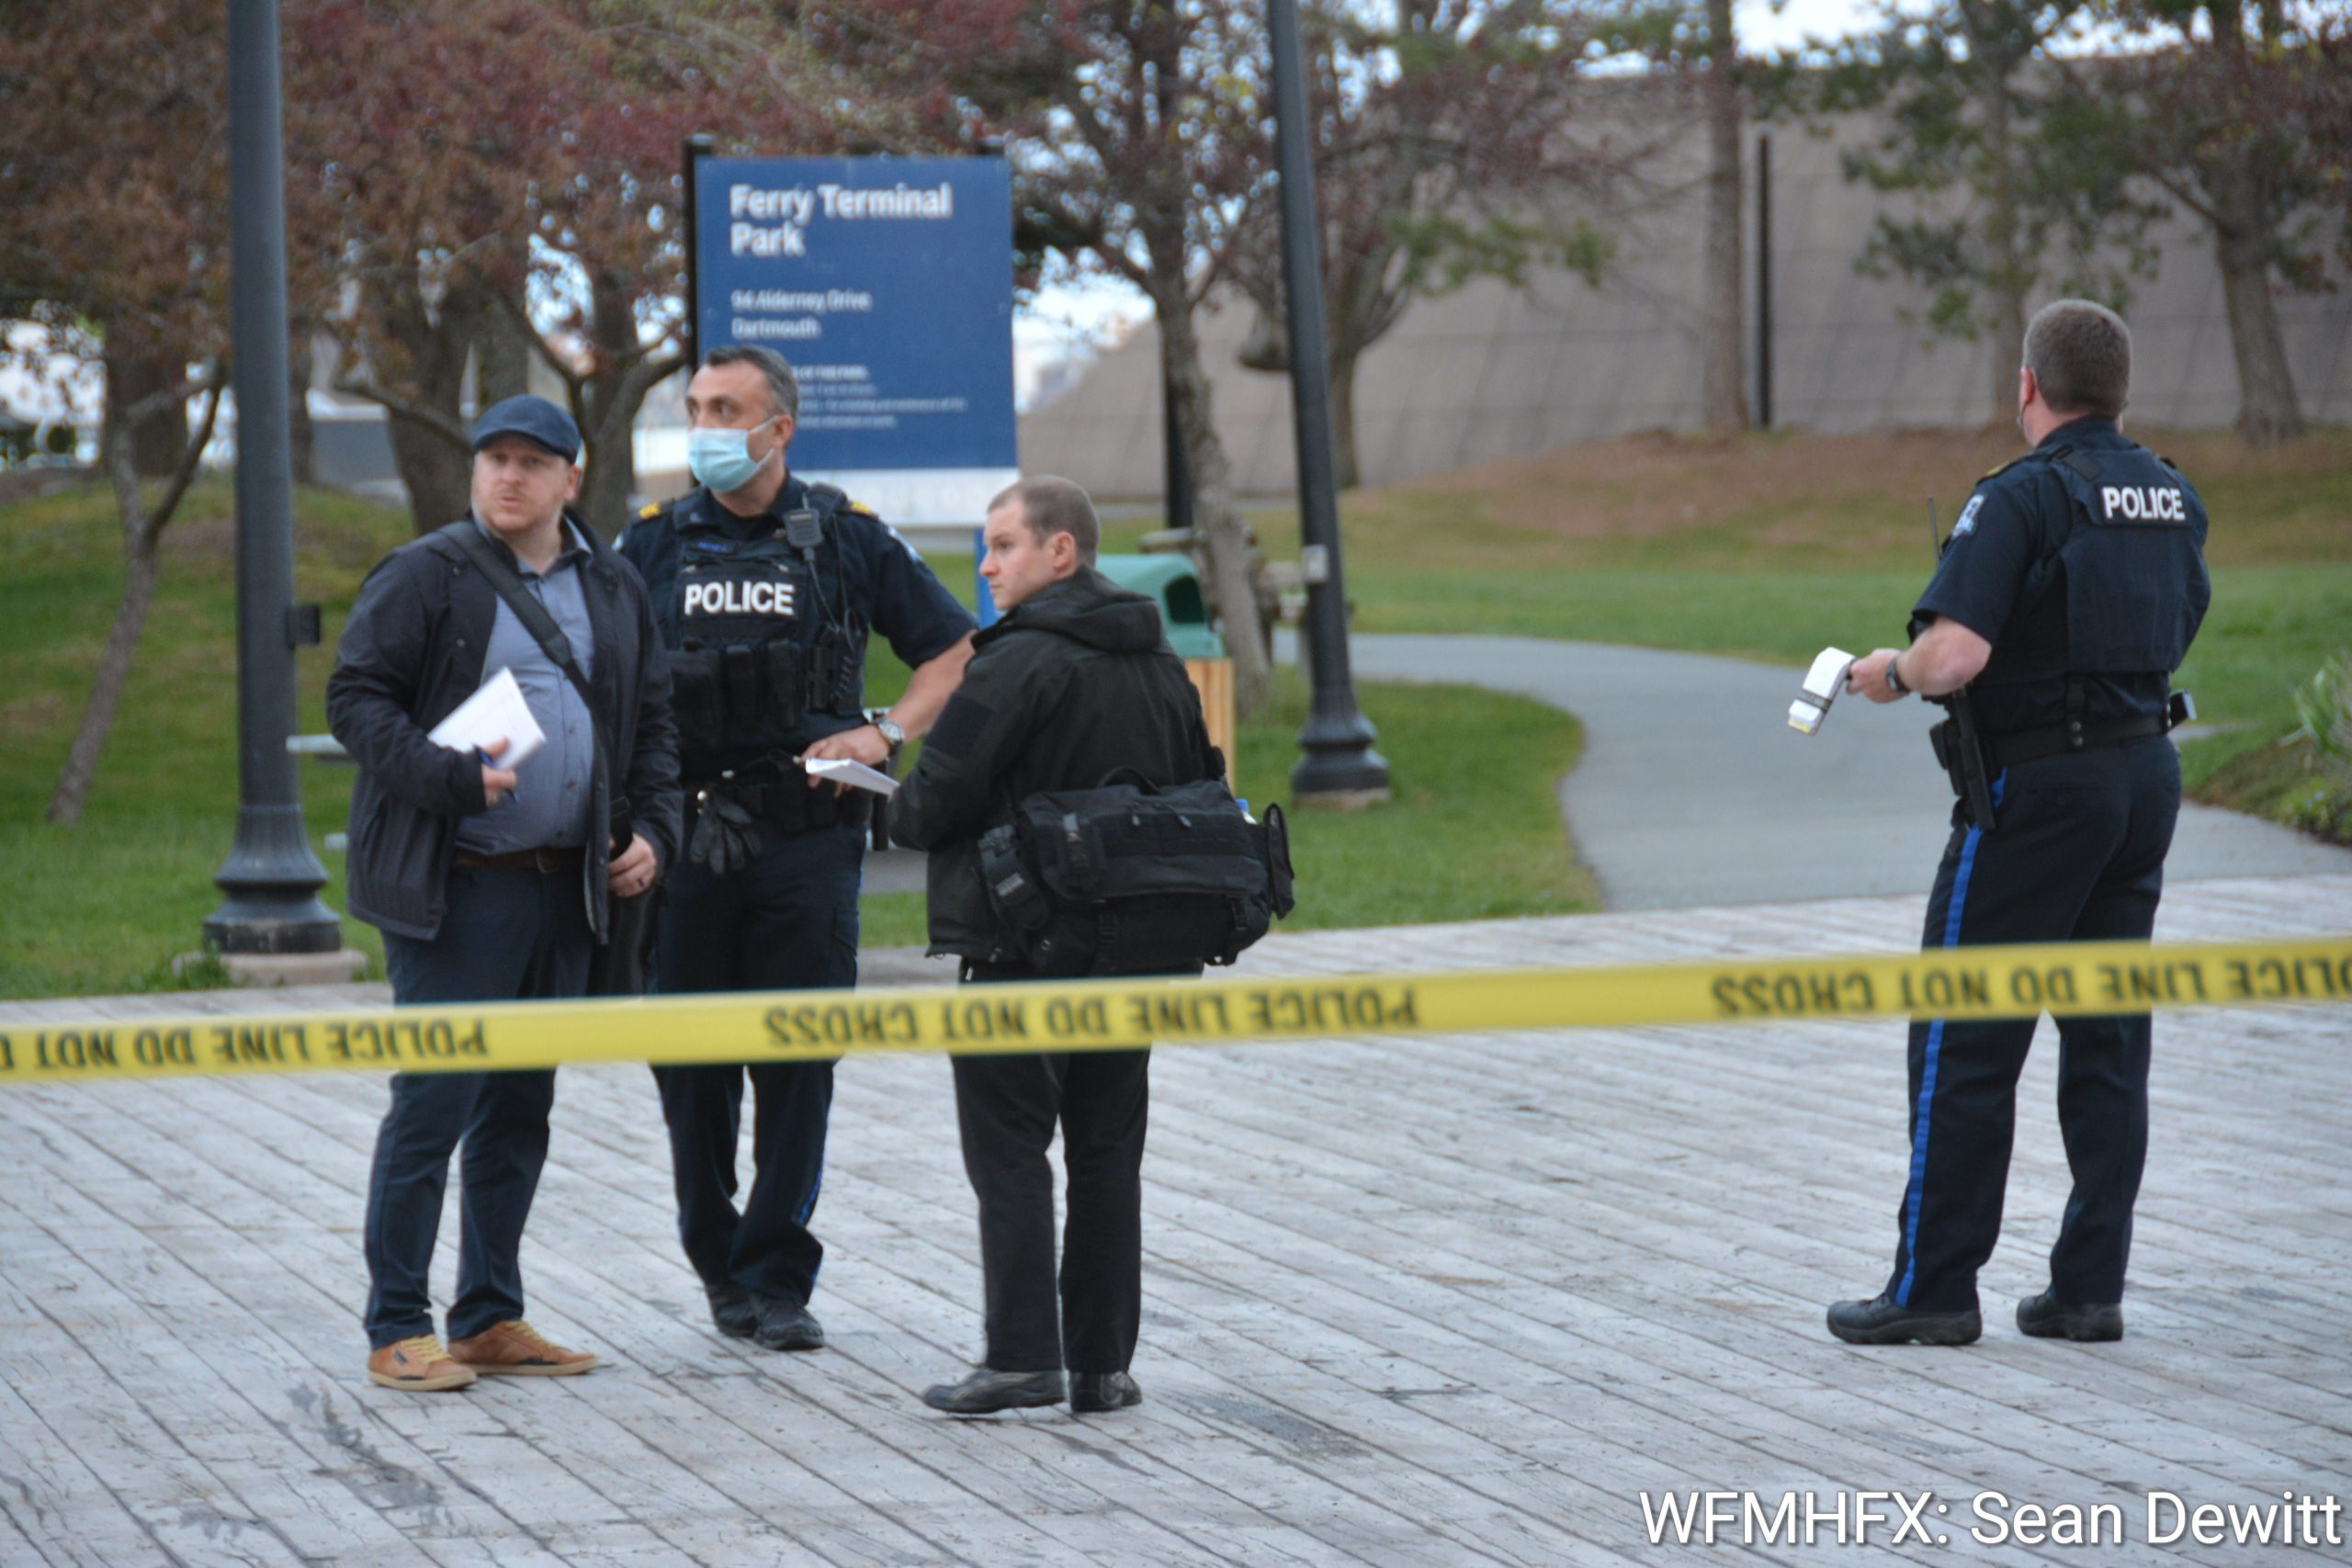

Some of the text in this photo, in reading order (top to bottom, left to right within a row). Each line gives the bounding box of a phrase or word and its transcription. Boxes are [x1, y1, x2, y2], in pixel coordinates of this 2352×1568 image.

[730, 182, 953, 225] Ferry Terminal
[730, 221, 807, 257] Park
[731, 316, 820, 339] Dartmouth
[2101, 486, 2186, 521] POLICE
[684, 581, 795, 616] POLICE
[1712, 972, 1876, 1016] CROSS
[1899, 970, 1991, 1010] NOT
[2010, 964, 2080, 1006] DO
[2098, 961, 2211, 1003] LINE
[763, 983, 1420, 1047] POLICE LINE DO NOT CROSS
[35, 1030, 119, 1071] NOT
[133, 1026, 197, 1067] DO
[210, 1021, 312, 1066] LINE
[325, 1018, 489, 1060] POLICE
